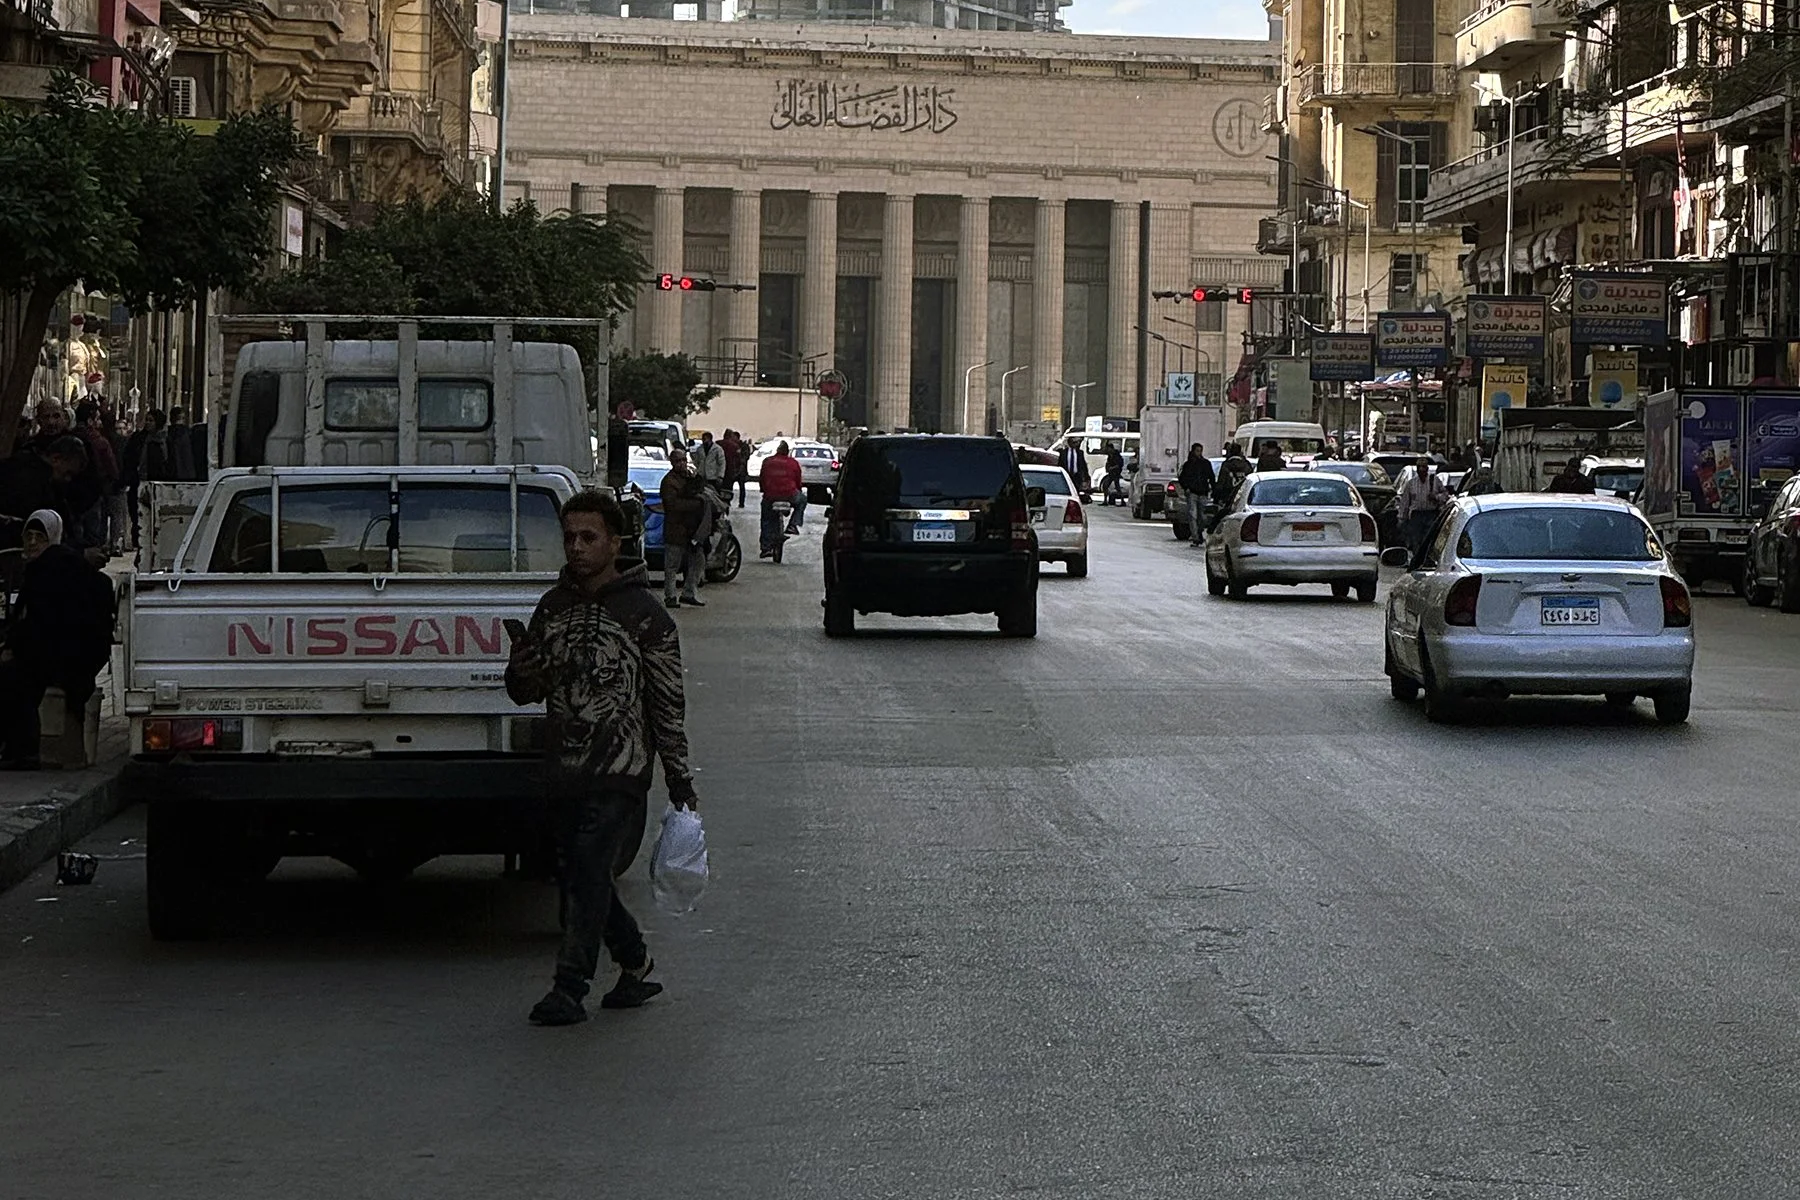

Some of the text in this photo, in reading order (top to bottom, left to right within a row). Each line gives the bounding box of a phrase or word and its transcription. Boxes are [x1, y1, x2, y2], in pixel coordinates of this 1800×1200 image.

[1604, 285, 1662, 302] صيدلية
[1493, 305, 1542, 321] صيدلية
[1611, 303, 1648, 315] مايكل
[1401, 322, 1444, 335] صيدلية
[1499, 321, 1530, 332] مايكل
[1407, 335, 1434, 345] مايكل
[227, 615, 502, 657] NISSAN
[185, 696, 323, 711] POWER STEERING
